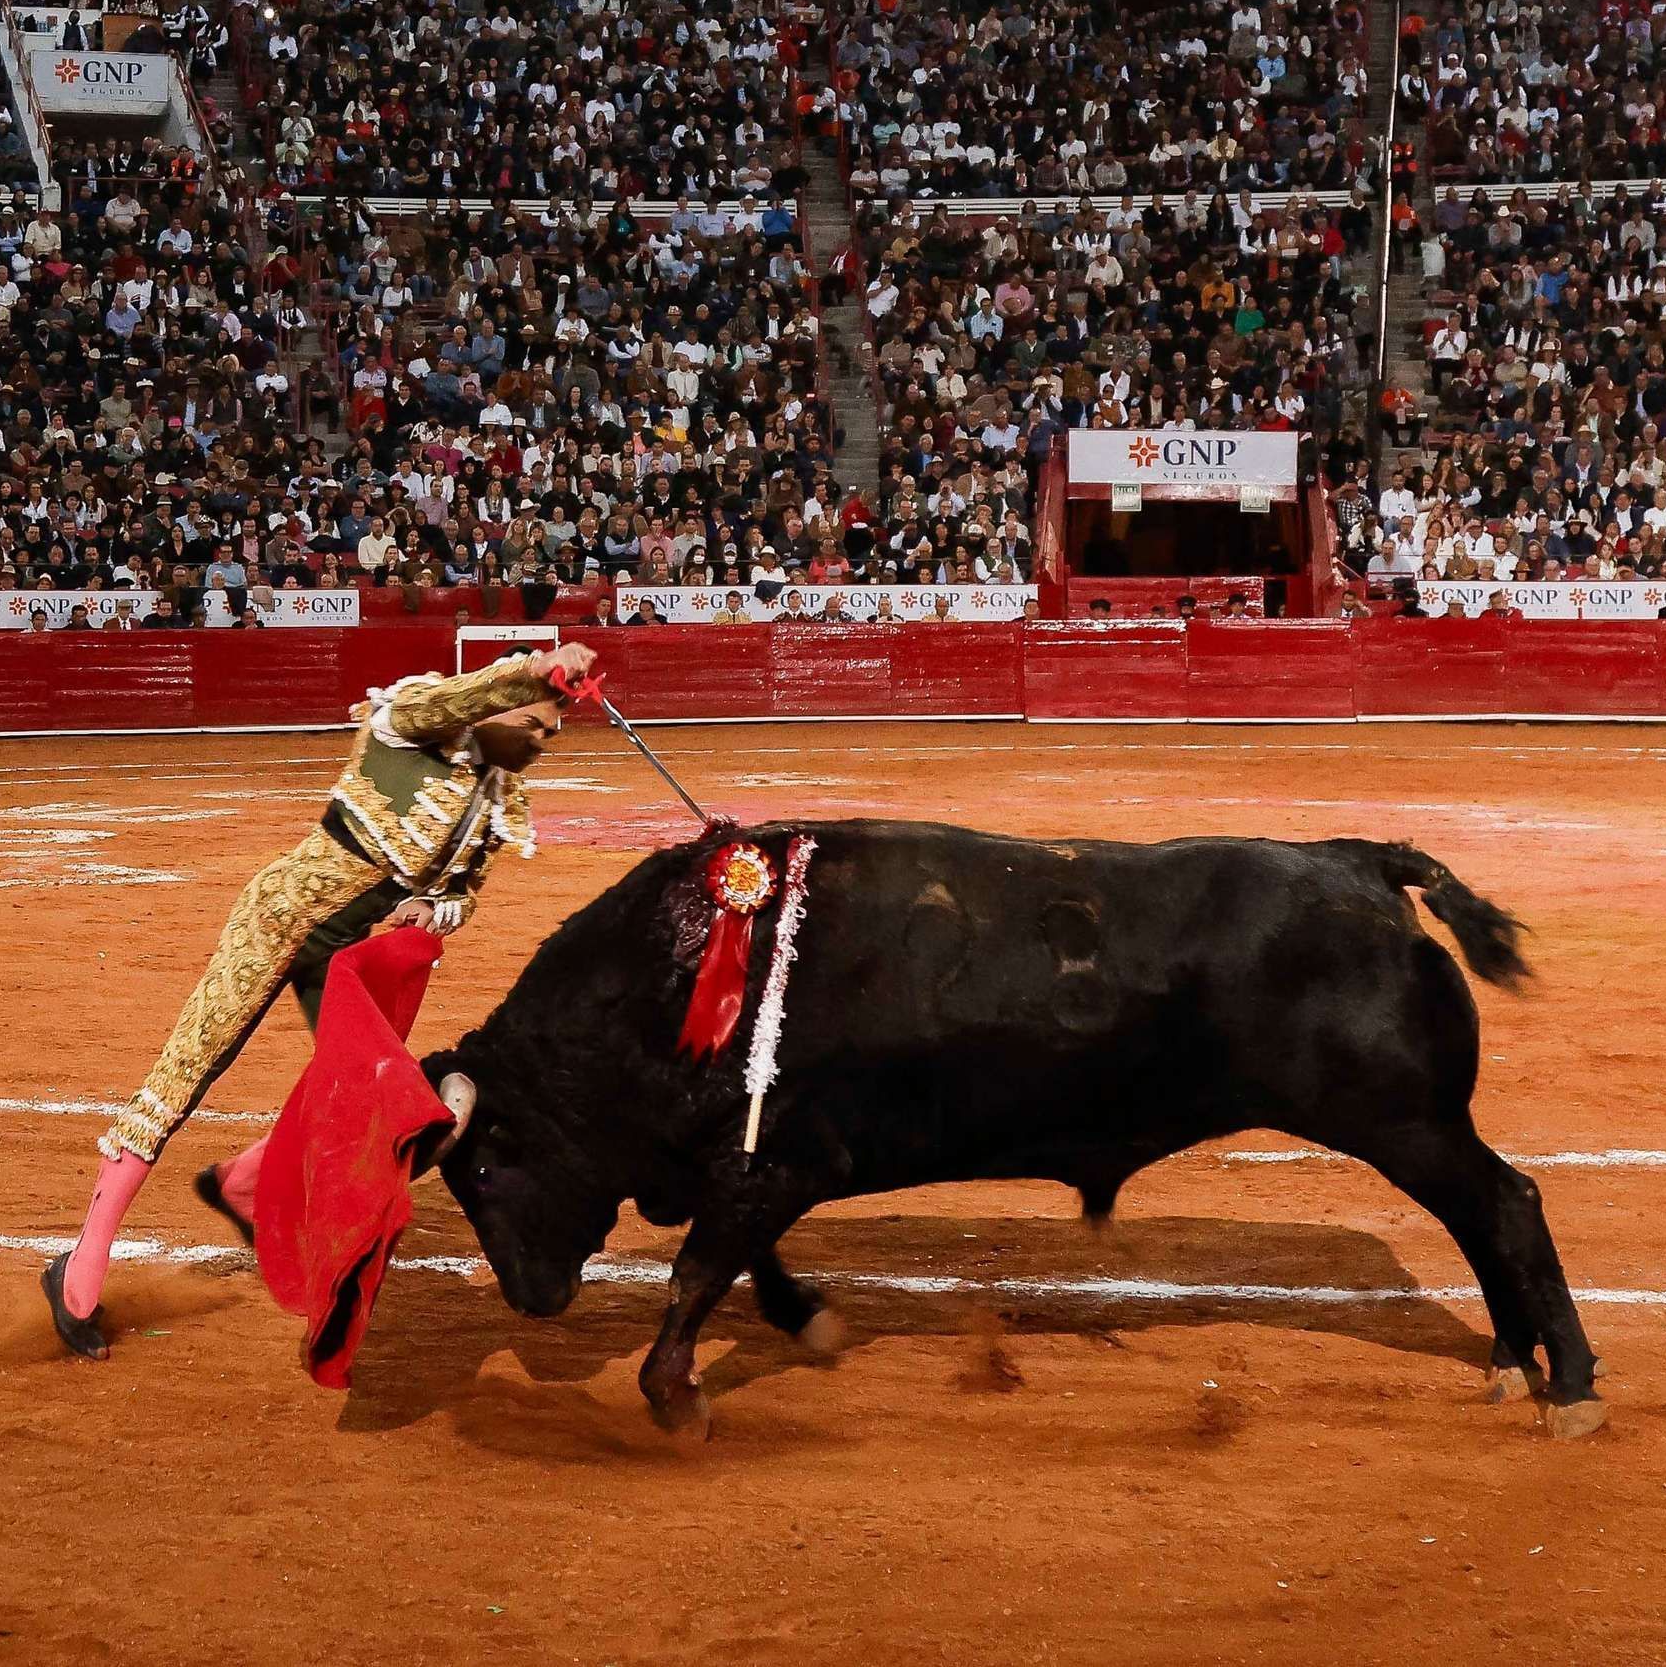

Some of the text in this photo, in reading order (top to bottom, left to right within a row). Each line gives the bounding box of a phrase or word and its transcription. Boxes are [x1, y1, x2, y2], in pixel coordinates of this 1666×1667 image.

[83, 60, 143, 84] GNP
[83, 87, 144, 97] SEGUROS
[1163, 438, 1237, 467] GNP
[710, 593, 751, 609] GP
[919, 592, 961, 608] GNP
[1441, 588, 1484, 604] GNP
[1515, 588, 1558, 604] GNP
[1589, 588, 1633, 605] GNP
[28, 598, 71, 616] GNP
[311, 597, 353, 614] GNP
